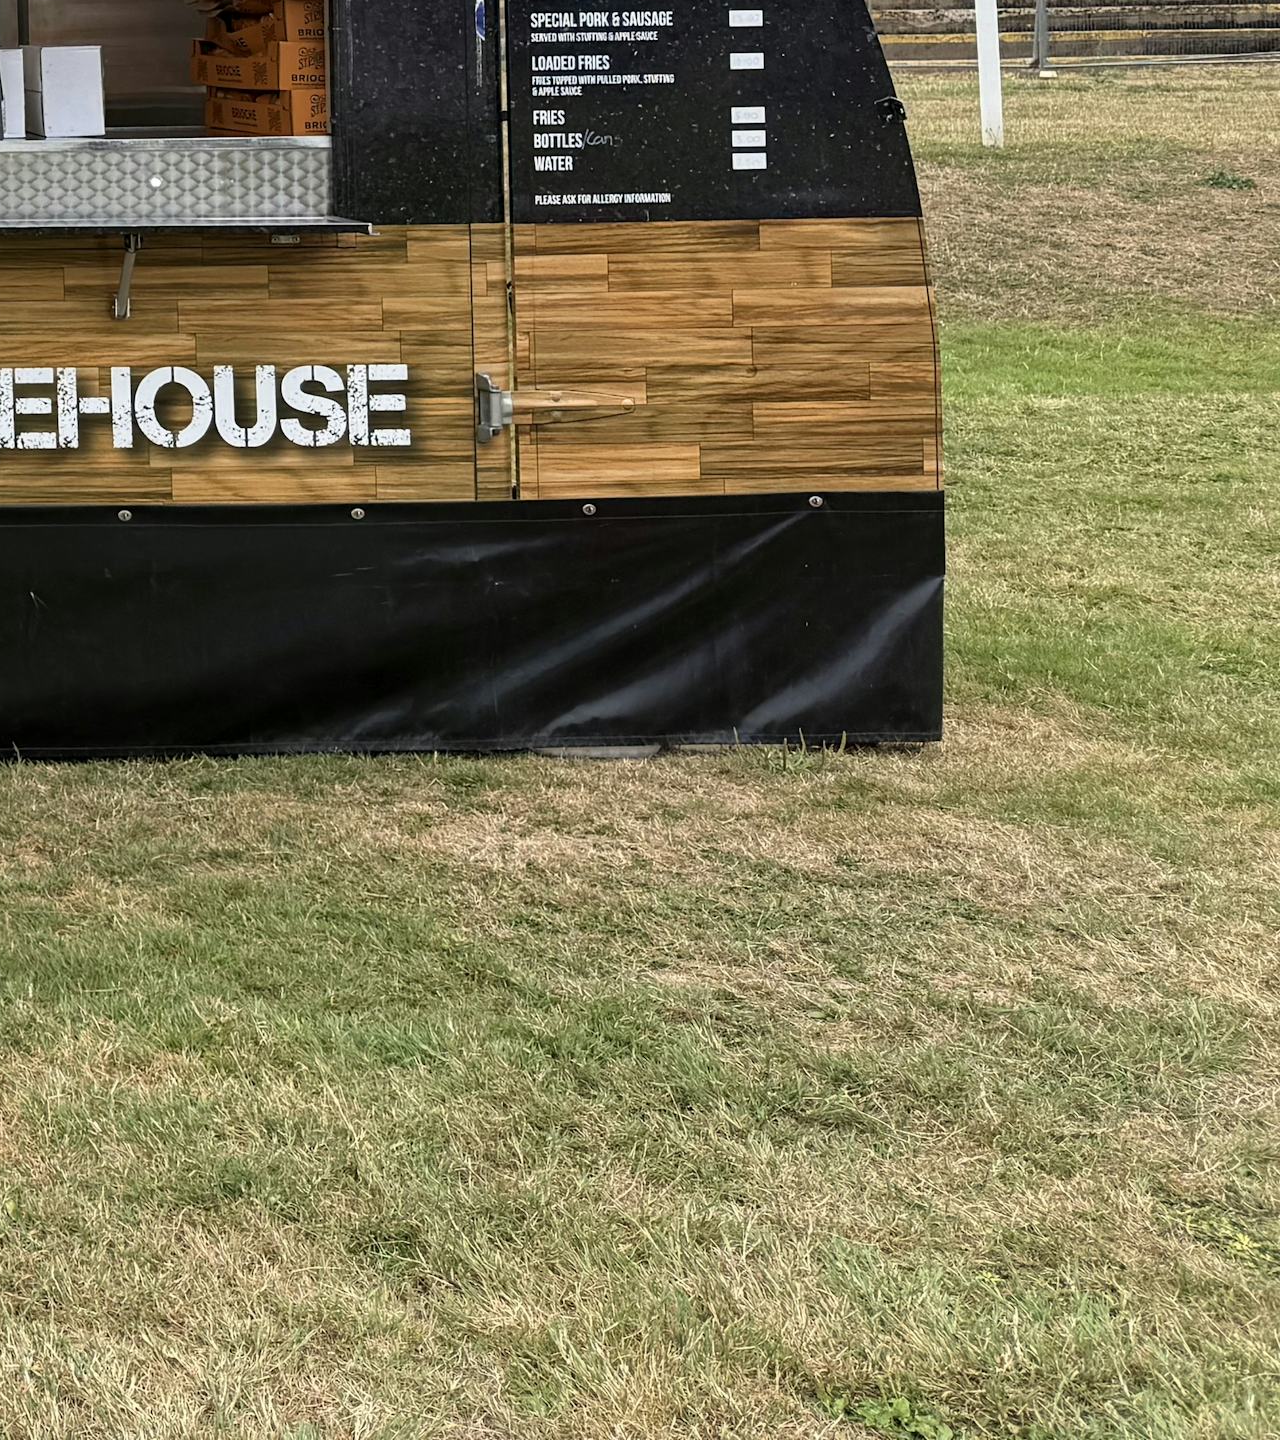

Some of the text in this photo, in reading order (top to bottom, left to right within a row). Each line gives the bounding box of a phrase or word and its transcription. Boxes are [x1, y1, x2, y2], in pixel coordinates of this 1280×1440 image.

[531, 11, 673, 30] SPECIAL PORK & SAUSAGE
[532, 55, 610, 71] LOADED FRIES
[533, 110, 565, 125] FRIES
[534, 133, 583, 149] BOTTLES
[534, 156, 573, 171] WATER
[535, 193, 671, 205] PLEASE ASK FOR ALLERGY INFORMATION
